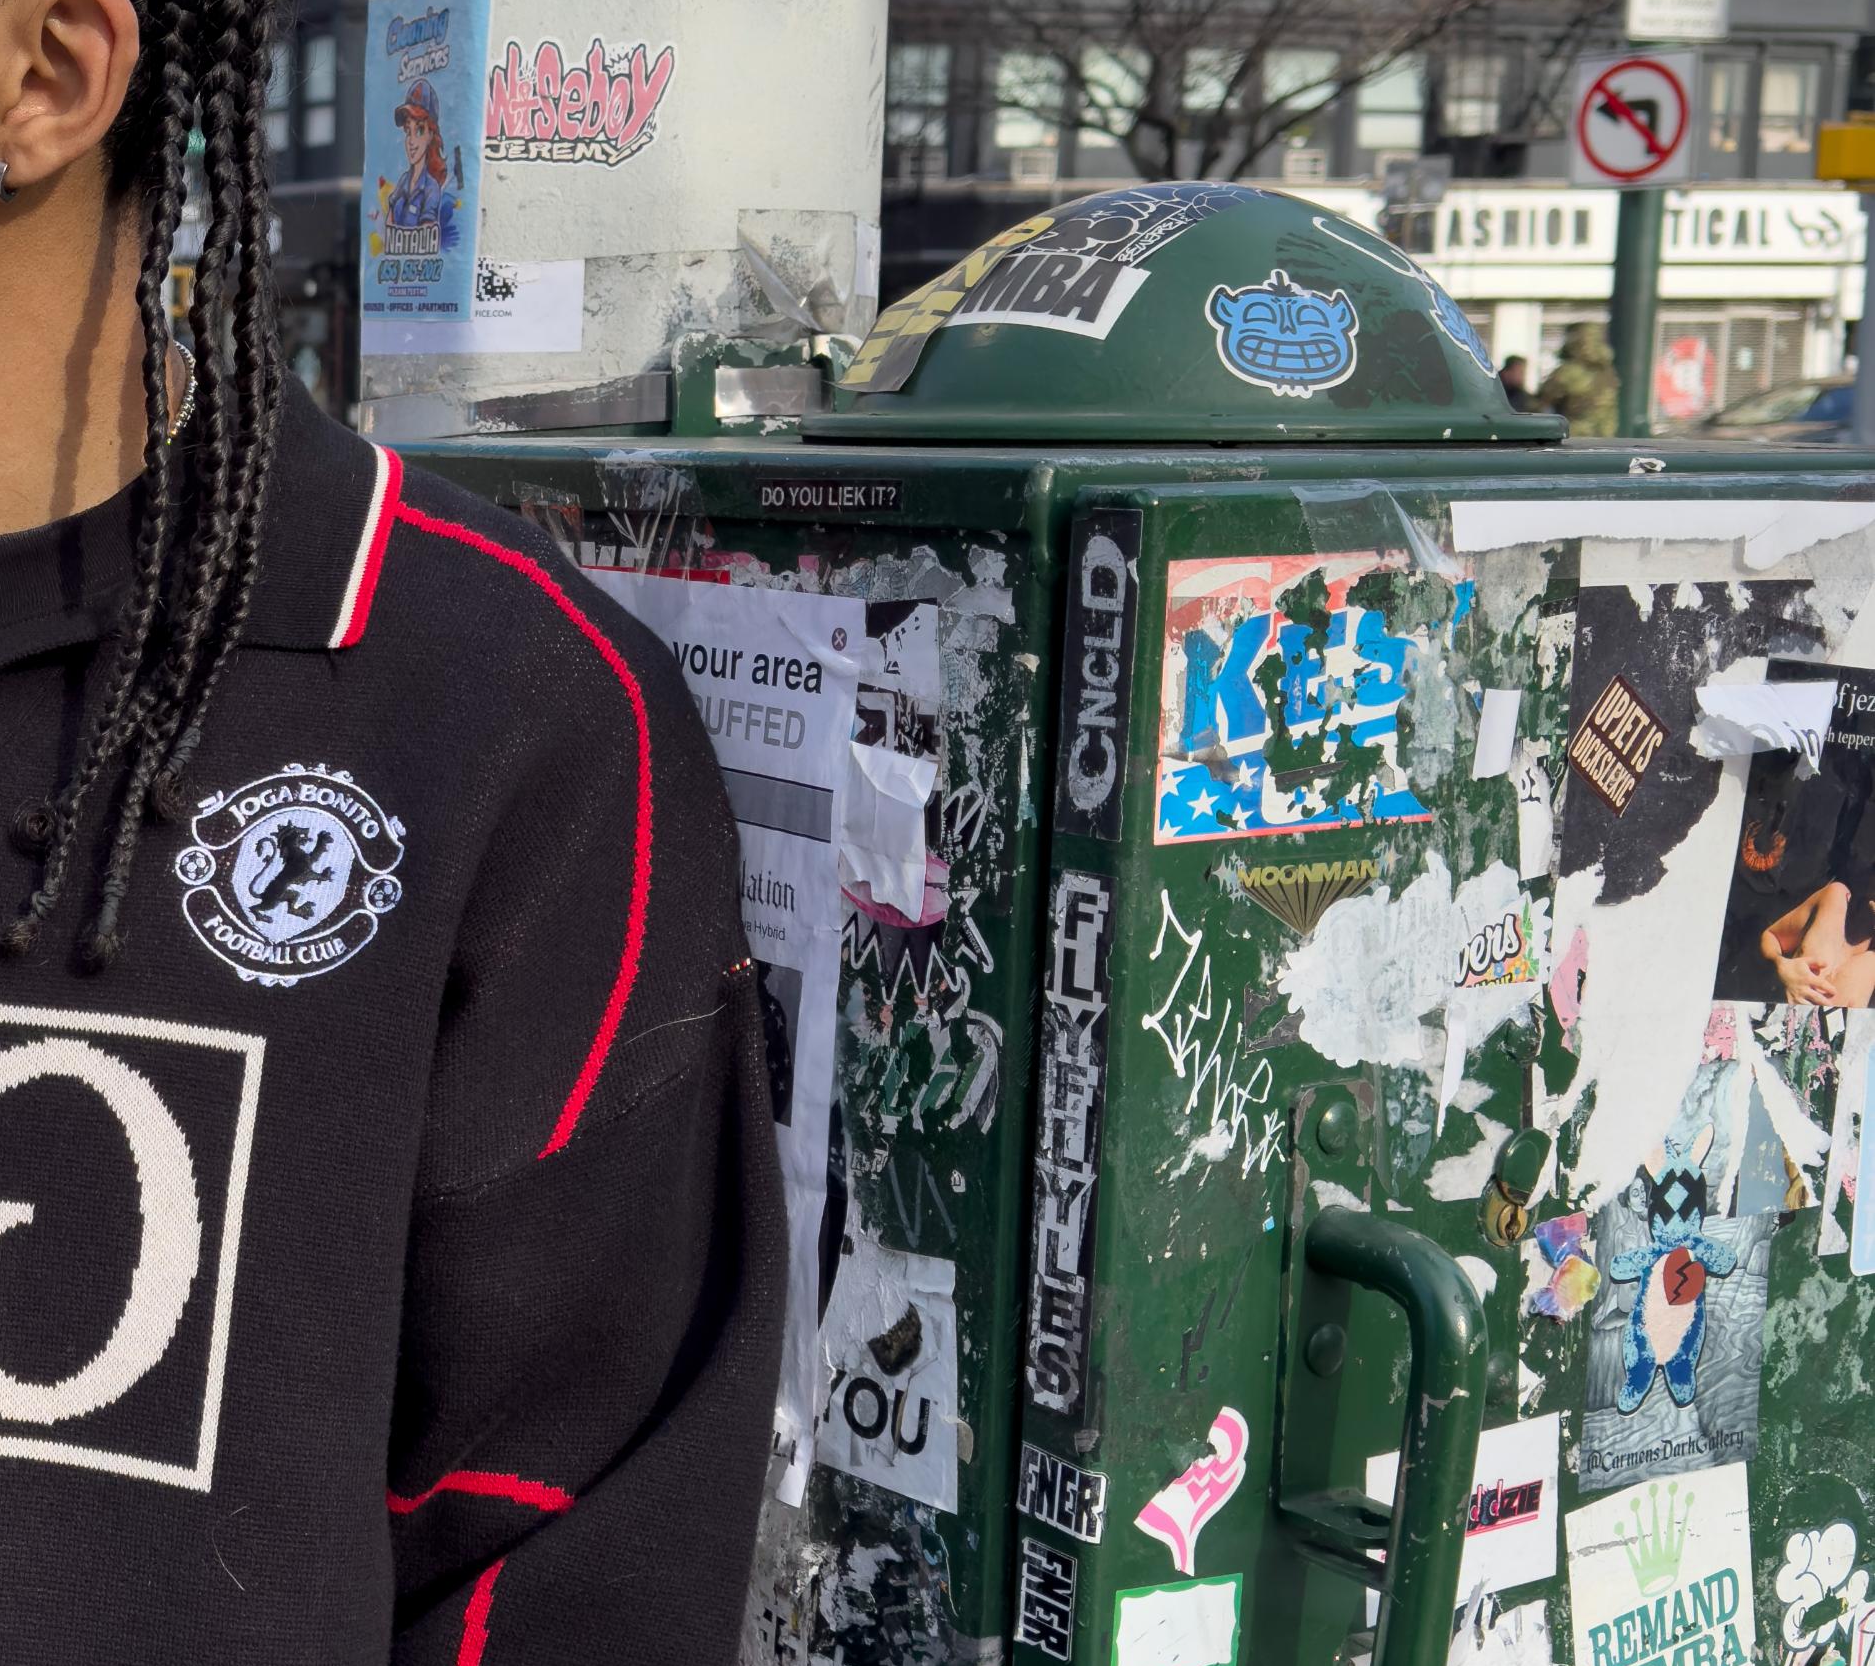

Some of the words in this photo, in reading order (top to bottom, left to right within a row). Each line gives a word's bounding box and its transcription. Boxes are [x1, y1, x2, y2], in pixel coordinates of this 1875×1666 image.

[386, 6, 450, 56] Cleaning
[398, 45, 450, 84] Services
[485, 135, 651, 167] JEREMY
[385, 225, 441, 255] NATALIA
[1447, 207, 1592, 247] ASHION
[1667, 207, 1771, 247] TICAL
[761, 486, 785, 507] DO
[789, 486, 823, 507] YOU
[828, 486, 867, 507] LIEK
[871, 486, 897, 507] IT?
[673, 641, 743, 681] your
[751, 651, 823, 695] area
[695, 694, 806, 750] UFFED
[1571, 726, 1636, 808] DICKSLEXIC
[1630, 724, 1664, 773] IS
[229, 785, 295, 827] JOGA
[298, 784, 380, 839] BONITO
[1237, 859, 1380, 888] MOONMAN
[203, 915, 294, 964] FOOTBALL
[297, 937, 348, 964] CLUB
[754, 919, 786, 941] Hybrid
